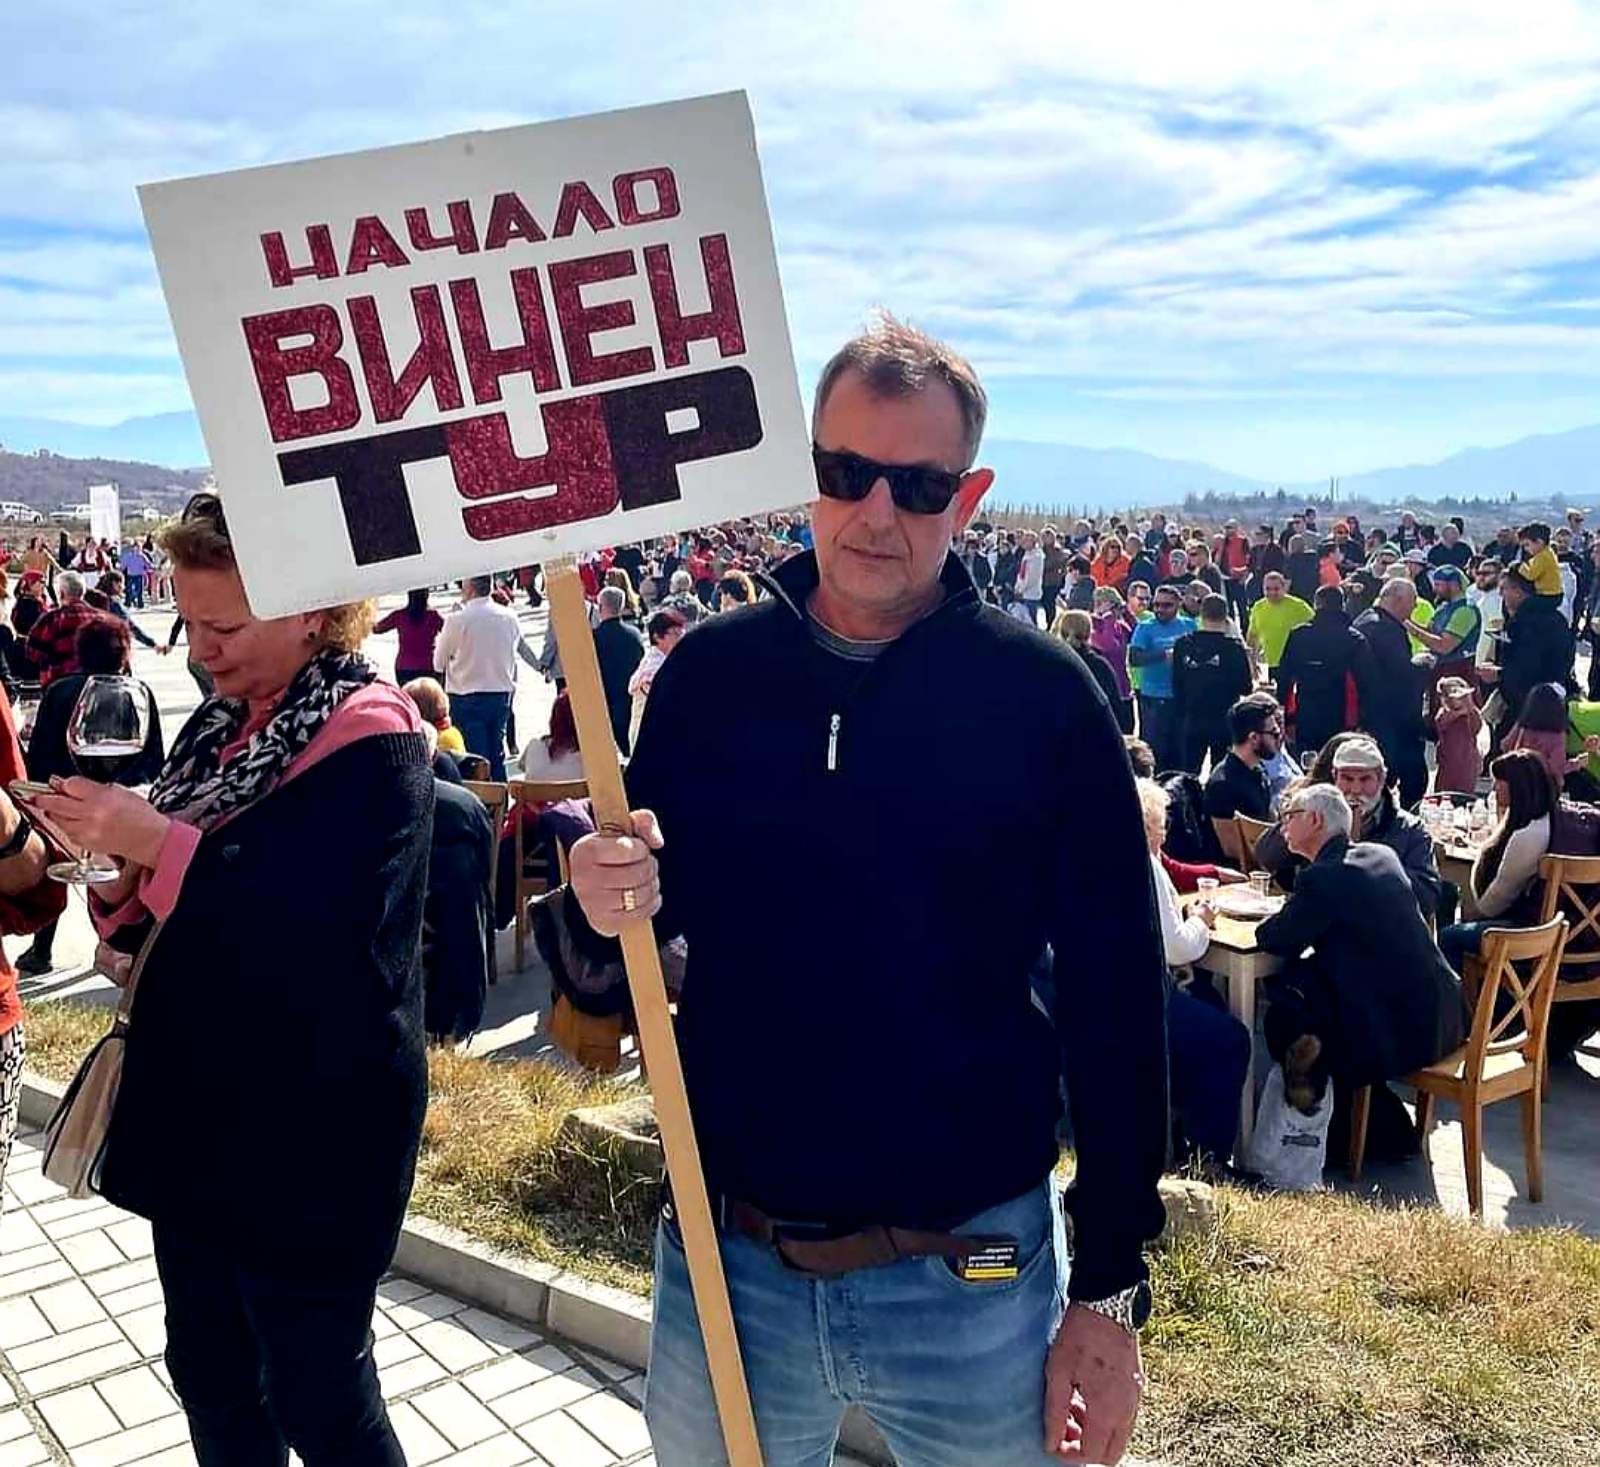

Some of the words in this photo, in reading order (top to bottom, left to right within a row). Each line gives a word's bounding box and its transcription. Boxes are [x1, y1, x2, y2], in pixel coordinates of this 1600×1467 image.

[261, 167, 680, 287] НАЧАЛО
[242, 233, 746, 442] ВИНЕН
[277, 365, 763, 565] ТУР
